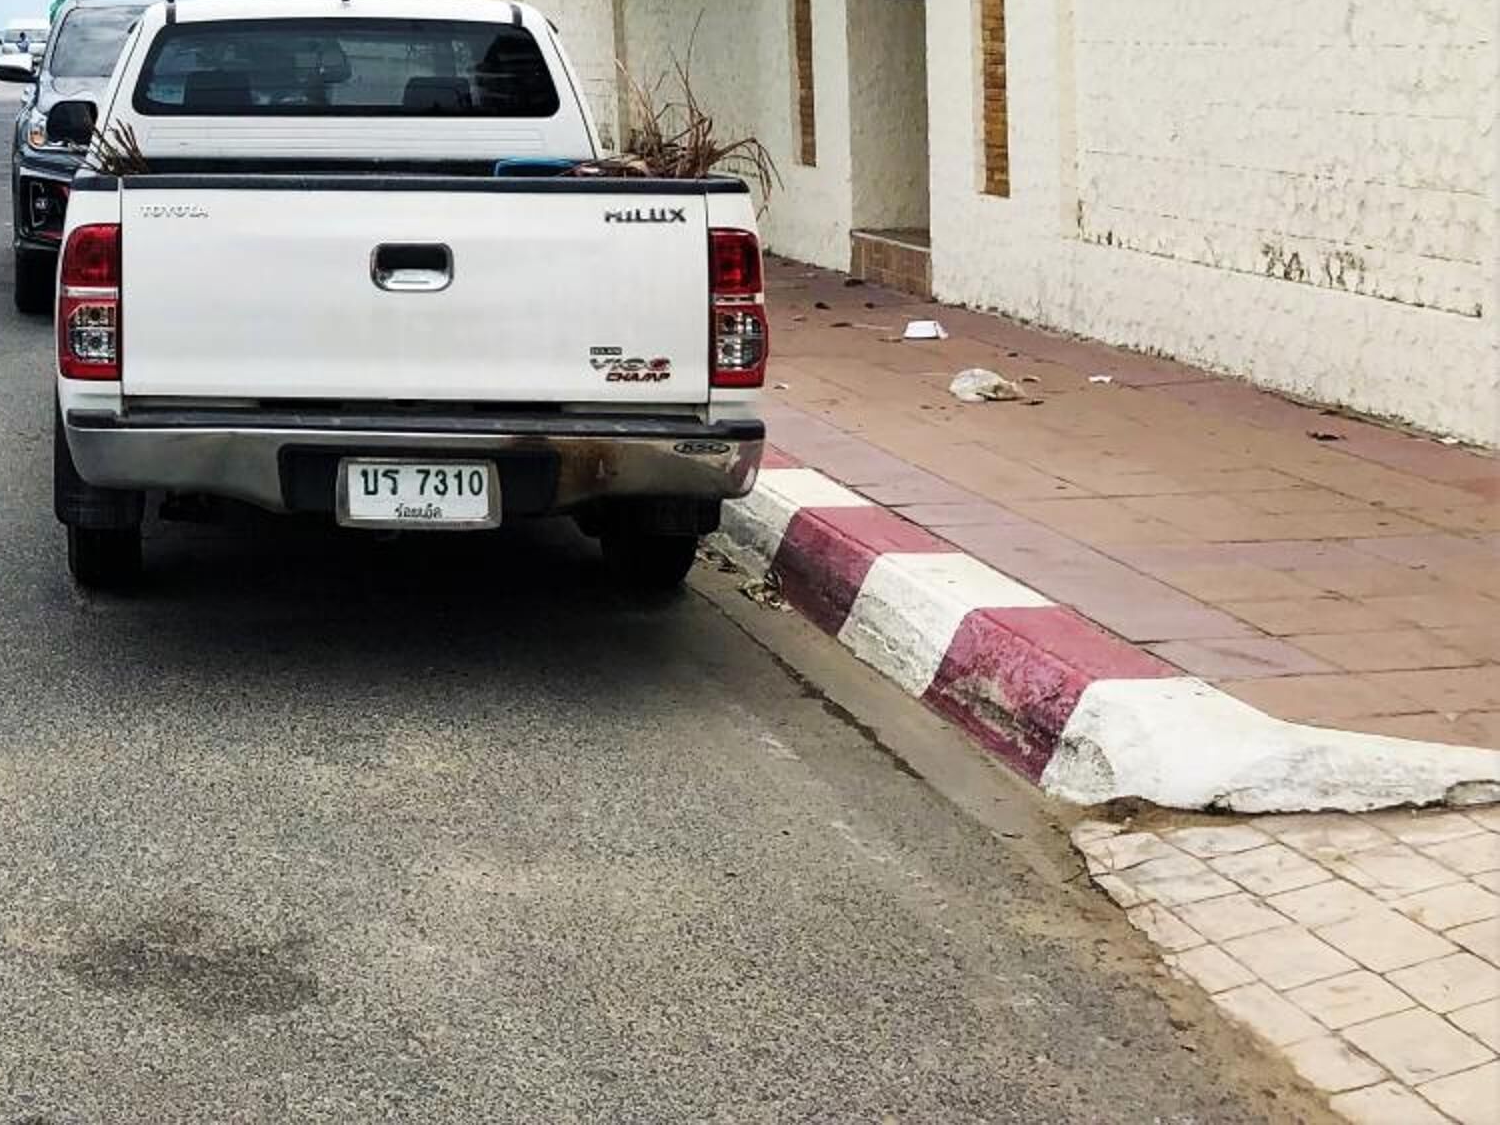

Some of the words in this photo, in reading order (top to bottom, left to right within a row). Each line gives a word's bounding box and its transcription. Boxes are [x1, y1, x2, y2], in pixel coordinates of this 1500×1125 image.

[141, 206, 208, 218] TOYOTA
[604, 207, 687, 223] HILUX
[361, 469, 399, 495] บร
[416, 469, 483, 495] 7310
